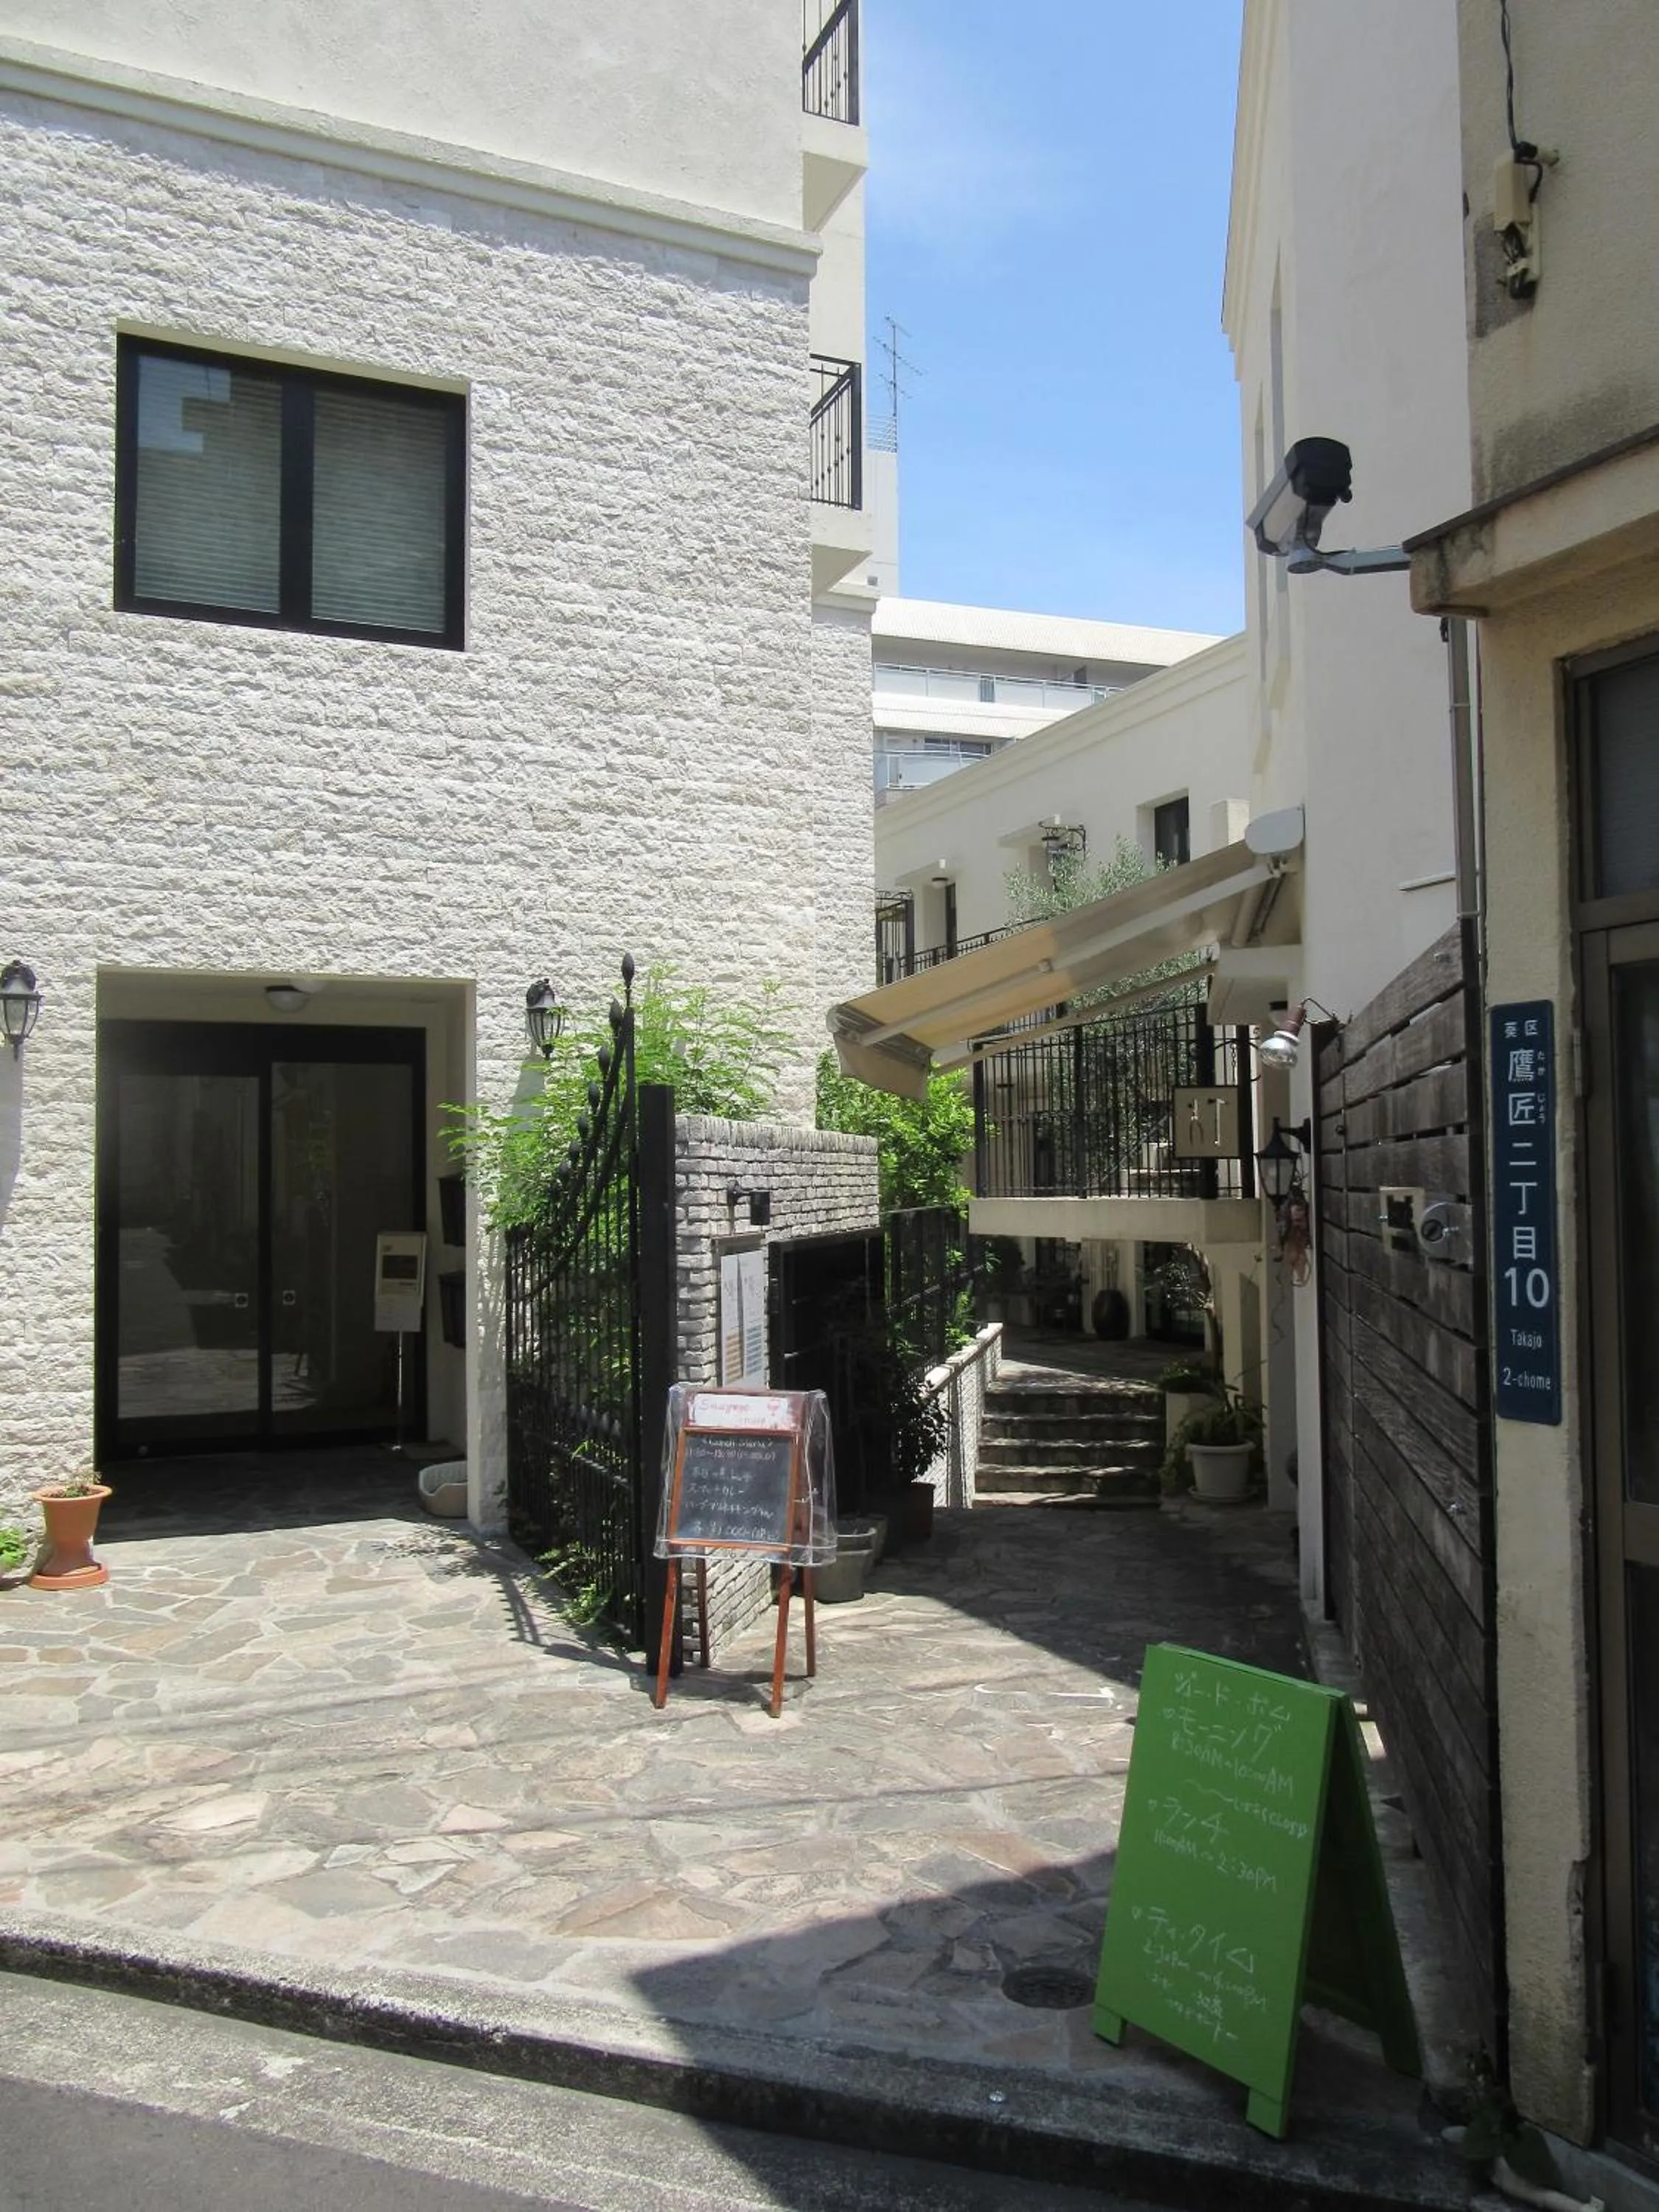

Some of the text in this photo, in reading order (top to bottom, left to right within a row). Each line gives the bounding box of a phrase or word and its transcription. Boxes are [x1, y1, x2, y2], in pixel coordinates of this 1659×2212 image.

[1503, 1020, 1539, 1039] 葵区
[1508, 1048, 1538, 1260] 鷹匠二丁目
[1504, 1267, 1550, 1308] 10
[1510, 1329, 1543, 1349] Takajo
[1502, 1368, 1552, 1390] 2-chome
[1179, 1706, 1284, 1764] モーニング
[1163, 1795, 1231, 1845] ランチ
